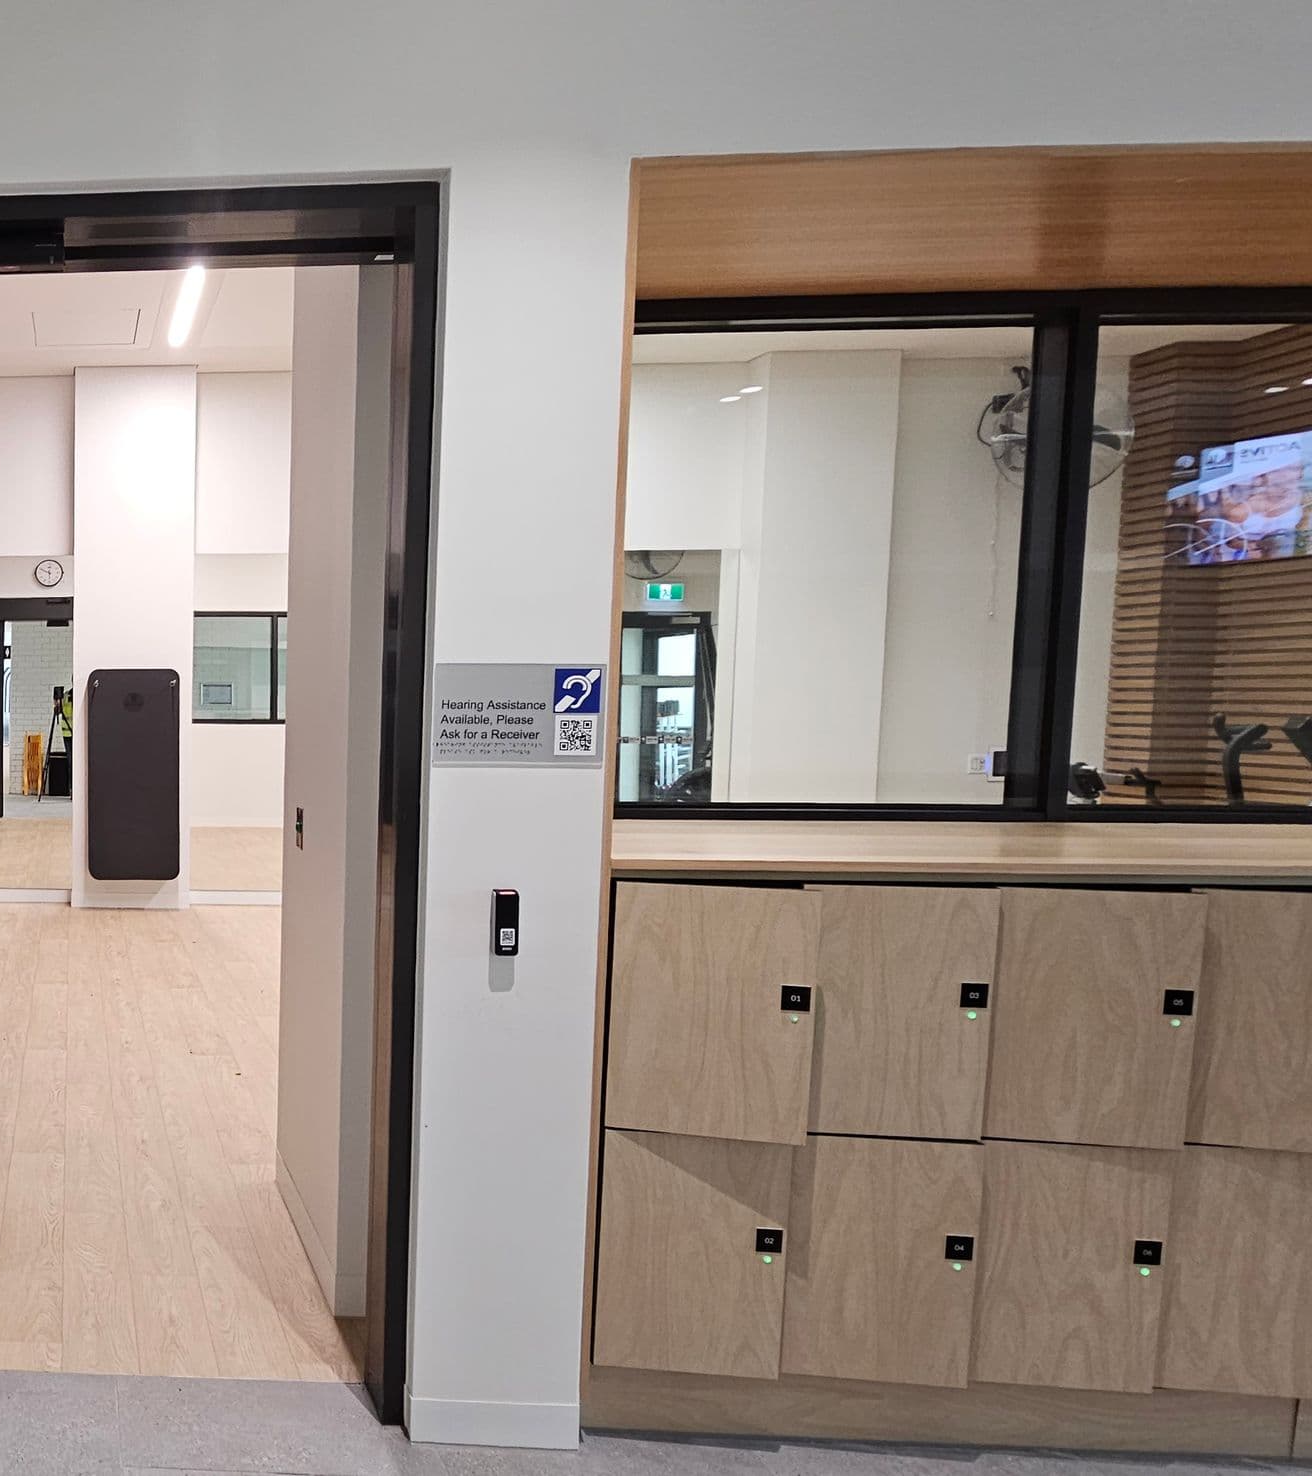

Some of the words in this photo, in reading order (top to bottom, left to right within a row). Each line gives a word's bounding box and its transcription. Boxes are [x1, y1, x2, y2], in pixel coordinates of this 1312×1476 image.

[441, 699, 484, 712] Hearing
[486, 700, 546, 710] Assistance
[440, 714, 493, 726] Available,
[496, 714, 534, 725] Please
[440, 729, 460, 739] Ask
[463, 729, 478, 739] for
[481, 731, 487, 739] a
[491, 729, 540, 739] Receiver
